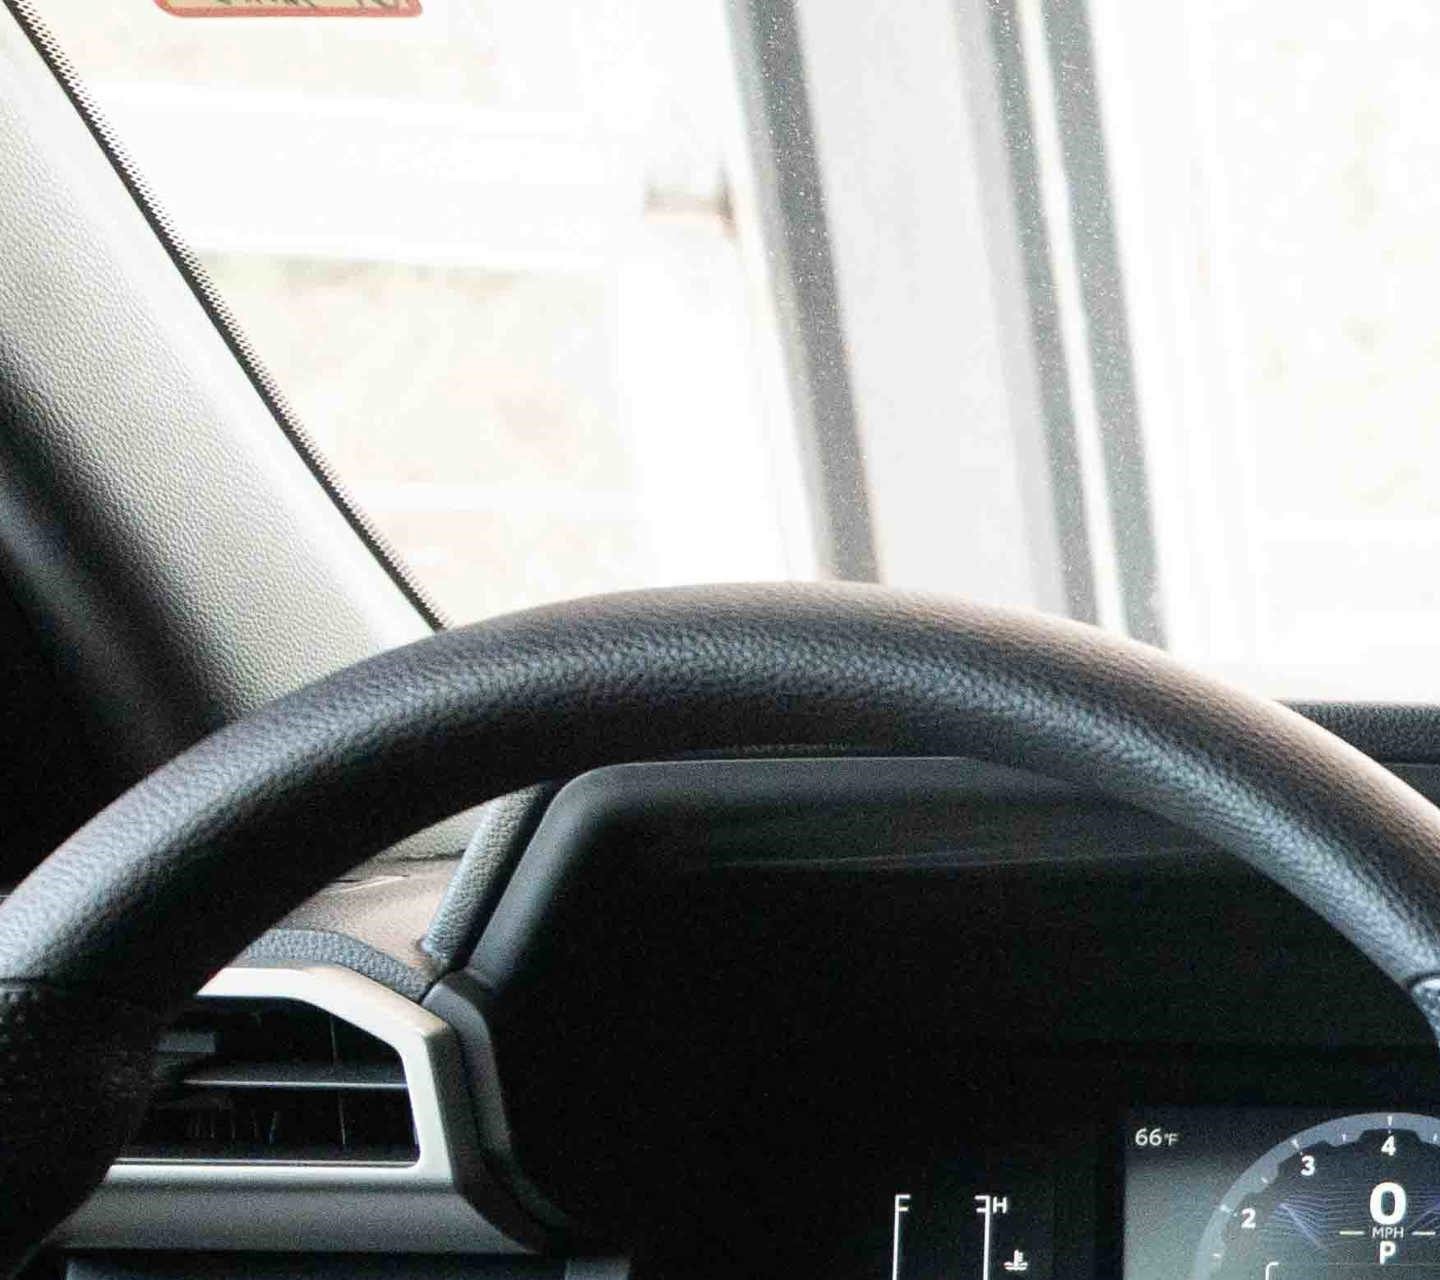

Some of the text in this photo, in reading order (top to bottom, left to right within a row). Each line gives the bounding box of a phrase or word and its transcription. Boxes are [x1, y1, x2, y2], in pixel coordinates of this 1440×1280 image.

[1380, 1135, 1397, 1157] 4
[1301, 1156, 1316, 1177] 3
[992, 1196, 1009, 1214] H
[1369, 1181, 1407, 1225] 0
[1241, 1208, 1257, 1229] 2
[1372, 1226, 1405, 1239] MPH
[1379, 1241, 1397, 1264] P
